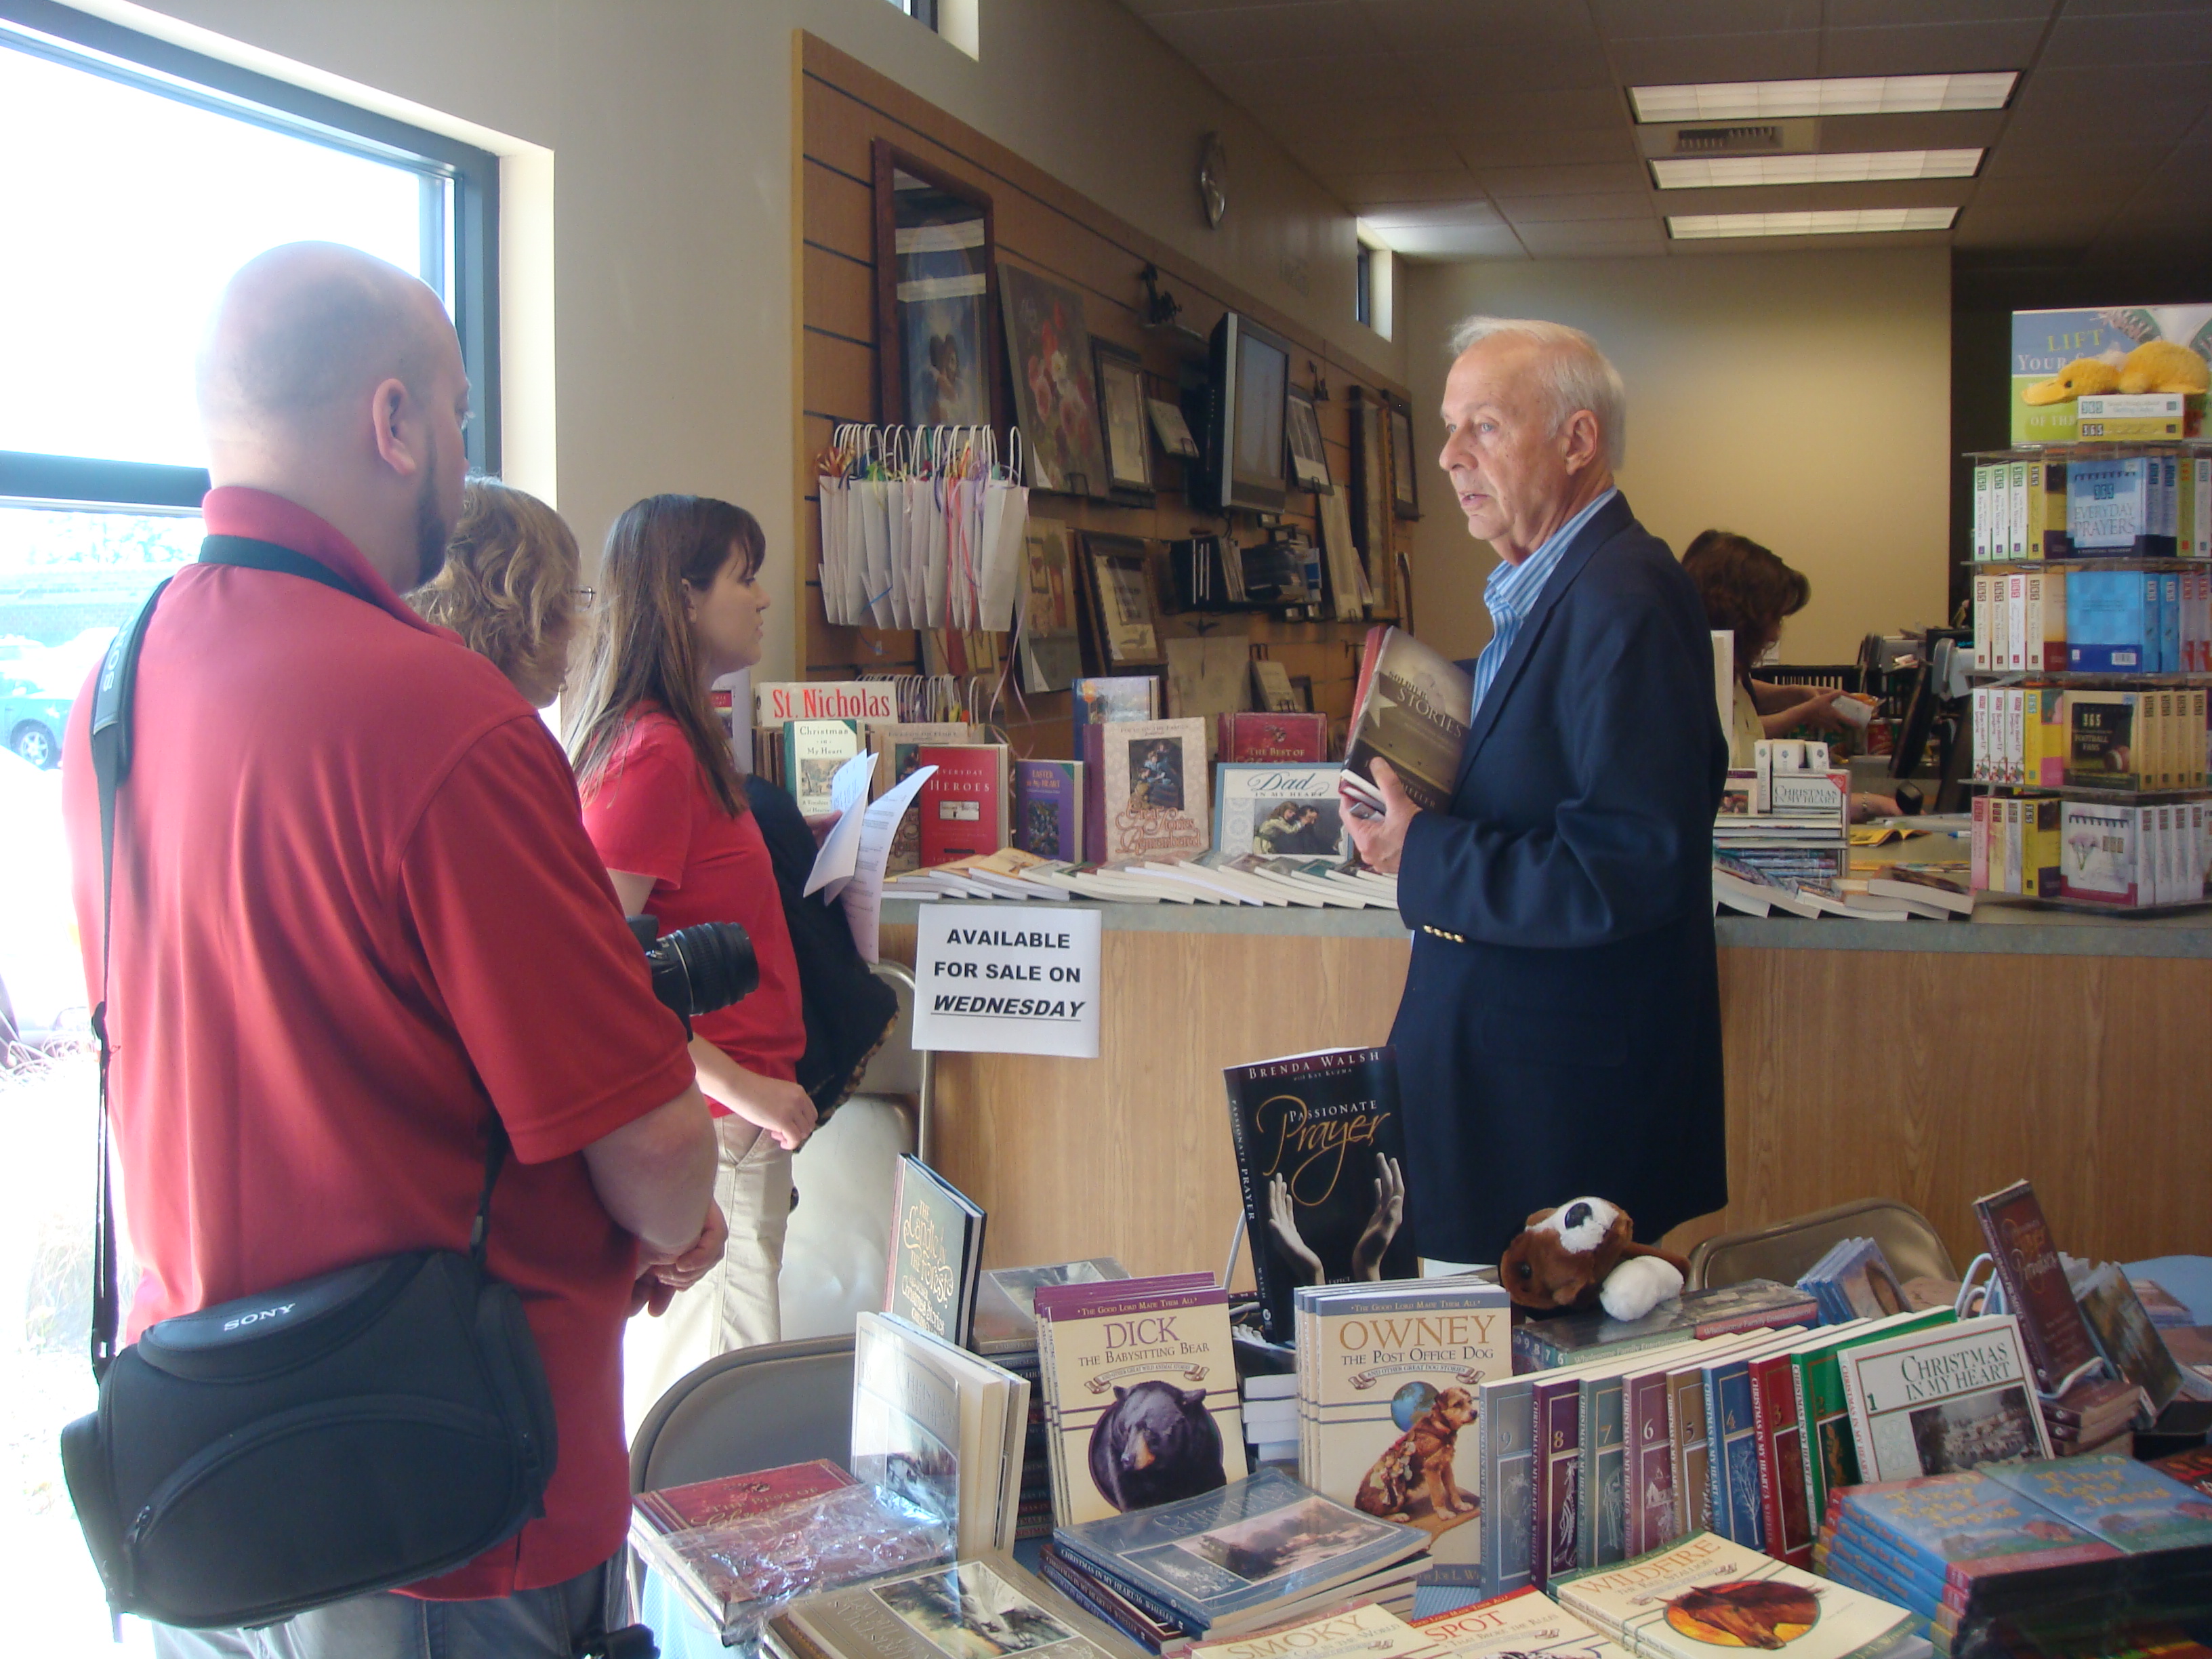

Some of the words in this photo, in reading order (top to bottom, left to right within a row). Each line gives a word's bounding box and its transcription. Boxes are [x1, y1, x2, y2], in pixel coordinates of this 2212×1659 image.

[2048, 329, 2104, 352] LIFT
[2083, 424, 2104, 436] 365
[2074, 503, 2133, 520] EVERYDAY
[2074, 518, 2135, 537] PRAYERS
[773, 688, 800, 719] St.
[803, 688, 890, 719] Nicholas
[1397, 687, 1461, 738] STORIES
[800, 726, 848, 735] Christmas
[1269, 747, 1291, 756] BEST
[930, 780, 990, 792] HEROES
[1248, 771, 1327, 794] Dad
[1774, 785, 1837, 798] CHRISTMAS
[947, 929, 1071, 949] AVAILABLE
[934, 962, 978, 979] FOR
[985, 964, 1042, 981] SALE
[1050, 966, 1081, 983] ON
[934, 995, 1086, 1018] WEDNESDAY
[1249, 1061, 1310, 1079] BRENDA
[1320, 1051, 1380, 1067] WALSH
[1290, 1100, 1378, 1122] PASSIONATE
[1232, 1100, 1246, 1163] PASSIONATE
[1241, 1168, 1255, 1221] PRAYER
[1256, 1094, 1391, 1206] Prayer
[919, 1199, 930, 1222] THE
[1120, 1304, 1137, 1312] LORD
[1139, 1301, 1158, 1309] MADE
[1160, 1299, 1179, 1307] THEM
[1355, 1304, 1368, 1312] THE
[1416, 1300, 1437, 1309] MADE
[224, 1303, 296, 1332] SONY
[1704, 1323, 1743, 1336] Wholesome
[1744, 1316, 1765, 1327] Family
[1103, 1316, 1181, 1349] DICK
[1340, 1315, 1496, 1351] OWNEY
[1078, 1355, 1101, 1366] THE
[1105, 1347, 1175, 1364] BABYSITTING
[1180, 1342, 1210, 1355] BEAR
[1342, 1354, 1366, 1365] THE
[1373, 1350, 1405, 1364] POST
[1410, 1347, 1456, 1361] OFFICE
[1462, 1346, 1494, 1359] DOG
[1545, 1349, 1551, 1361] 7
[1557, 1353, 1564, 1365] 6
[1902, 1343, 2008, 1382] CHRISTMAS
[1382, 1367, 1403, 1375] OTHER
[1906, 1382, 1925, 1401] IN
[1927, 1375, 1950, 1395] MY
[1955, 1361, 2010, 1389] HEART
[1793, 1365, 1804, 1417] CHRISTMAS
[1866, 1393, 1878, 1411] 1
[1704, 1382, 1713, 1436] CHRISTMAS
[1773, 1403, 1783, 1424] 3
[1841, 1365, 1857, 1416] CHRISTMAS
[1854, 1429, 1864, 1444] MY
[1531, 1400, 1539, 1454] CHRISTMAS
[1623, 1393, 1631, 1445] CHRISTMAS
[1726, 1411, 1736, 1430] 4
[1751, 1377, 1762, 1430] CHRISTMAS
[1759, 1443, 1766, 1457] MY
[1501, 1431, 1513, 1450] 9
[1554, 1431, 1564, 1448] 8
[1601, 1426, 1611, 1443] 7
[1643, 1419, 1654, 1440] 6
[1685, 1422, 1695, 1441] 5
[1046, 1557, 1073, 1582] CHRISTMAS
[1574, 1539, 1721, 1593] WILDFIRE
[1061, 1549, 1094, 1576] CHRISTMAS
[1095, 1570, 1103, 1579] IN
[1103, 1574, 1113, 1584] MY
[1145, 1599, 1175, 1623] WHEELER
[1227, 1614, 1368, 1659] SMOKY
[1425, 1610, 1507, 1641] SPOT
